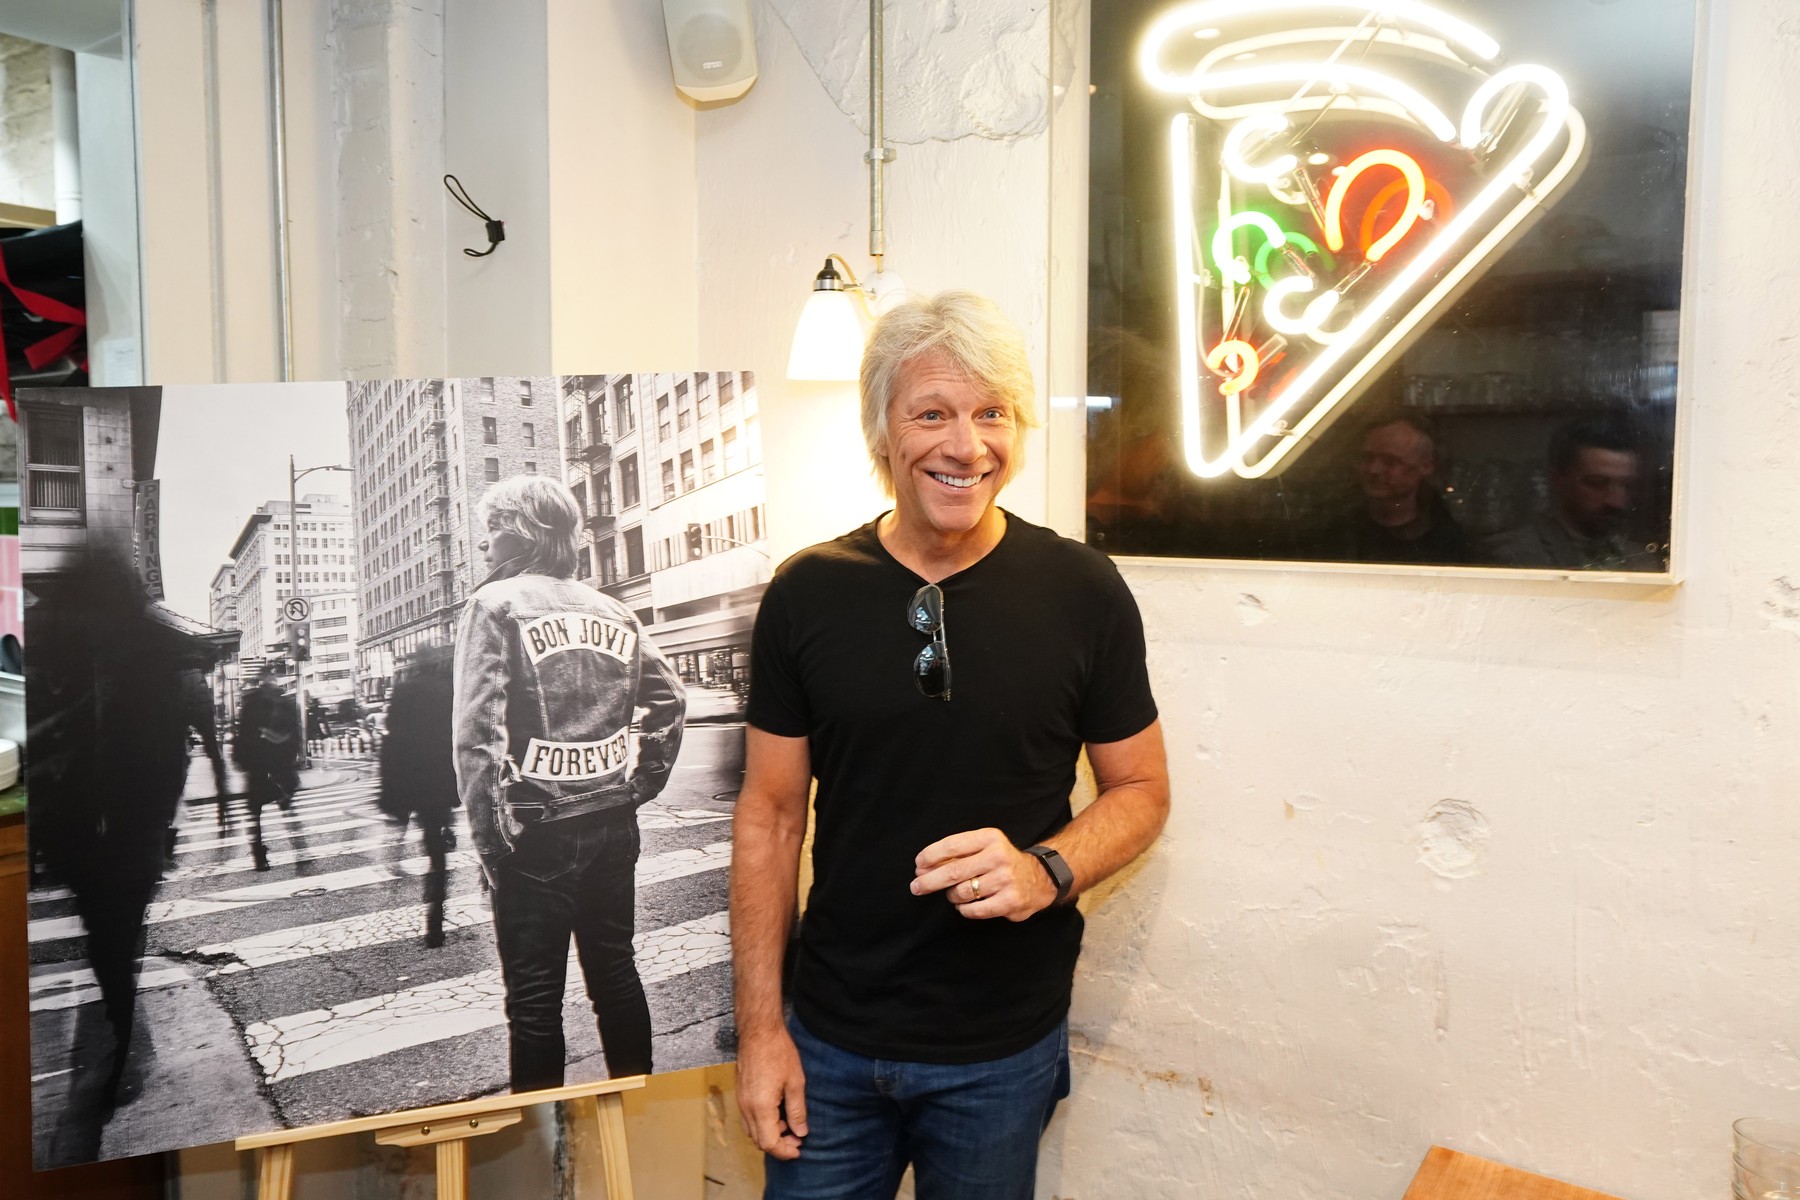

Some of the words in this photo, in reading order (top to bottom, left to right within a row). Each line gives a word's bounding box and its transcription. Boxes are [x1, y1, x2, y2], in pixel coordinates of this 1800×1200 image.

[143, 484, 160, 583] PARKING
[527, 617, 571, 657] BON
[579, 618, 629, 656] JOVI
[529, 733, 629, 776] FOREVER
